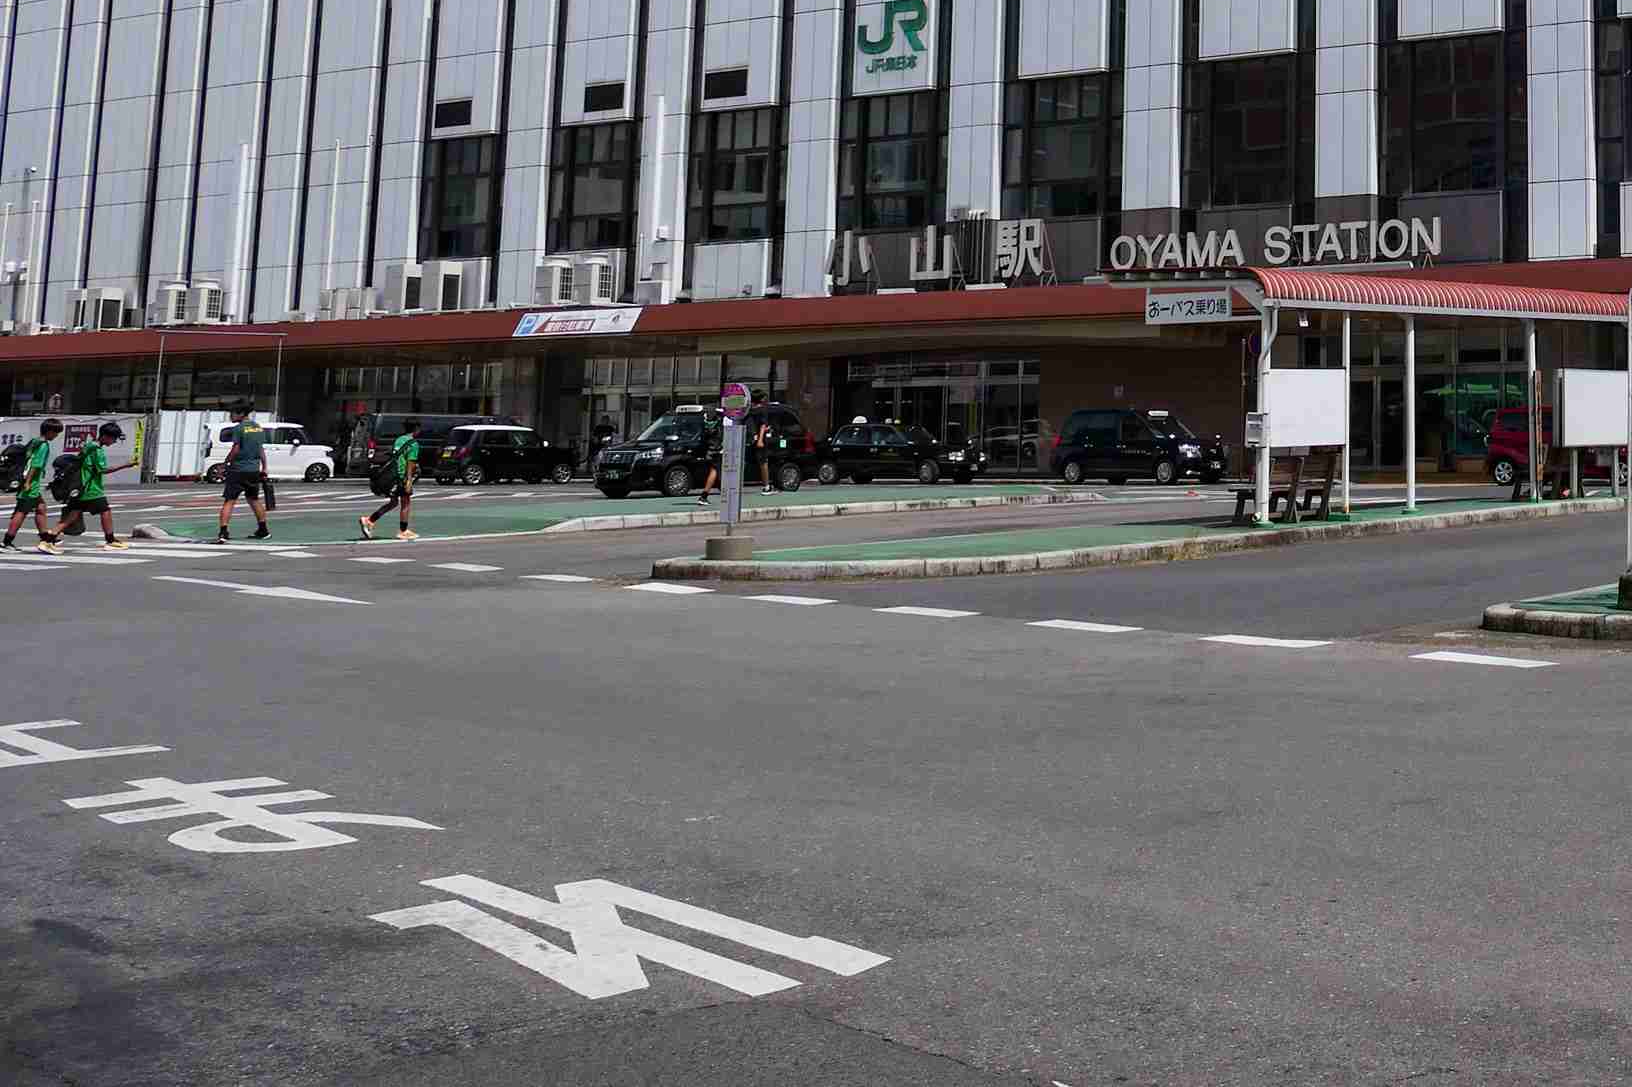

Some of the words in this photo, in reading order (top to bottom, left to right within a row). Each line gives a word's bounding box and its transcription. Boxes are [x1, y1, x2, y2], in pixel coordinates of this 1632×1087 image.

[857, 0, 928, 55] JR
[825, 218, 1046, 286] 小山駅
[1110, 229, 1246, 270] OYAMA
[1264, 216, 1442, 264] STATION
[1148, 298, 1228, 318] おーバス乗り場
